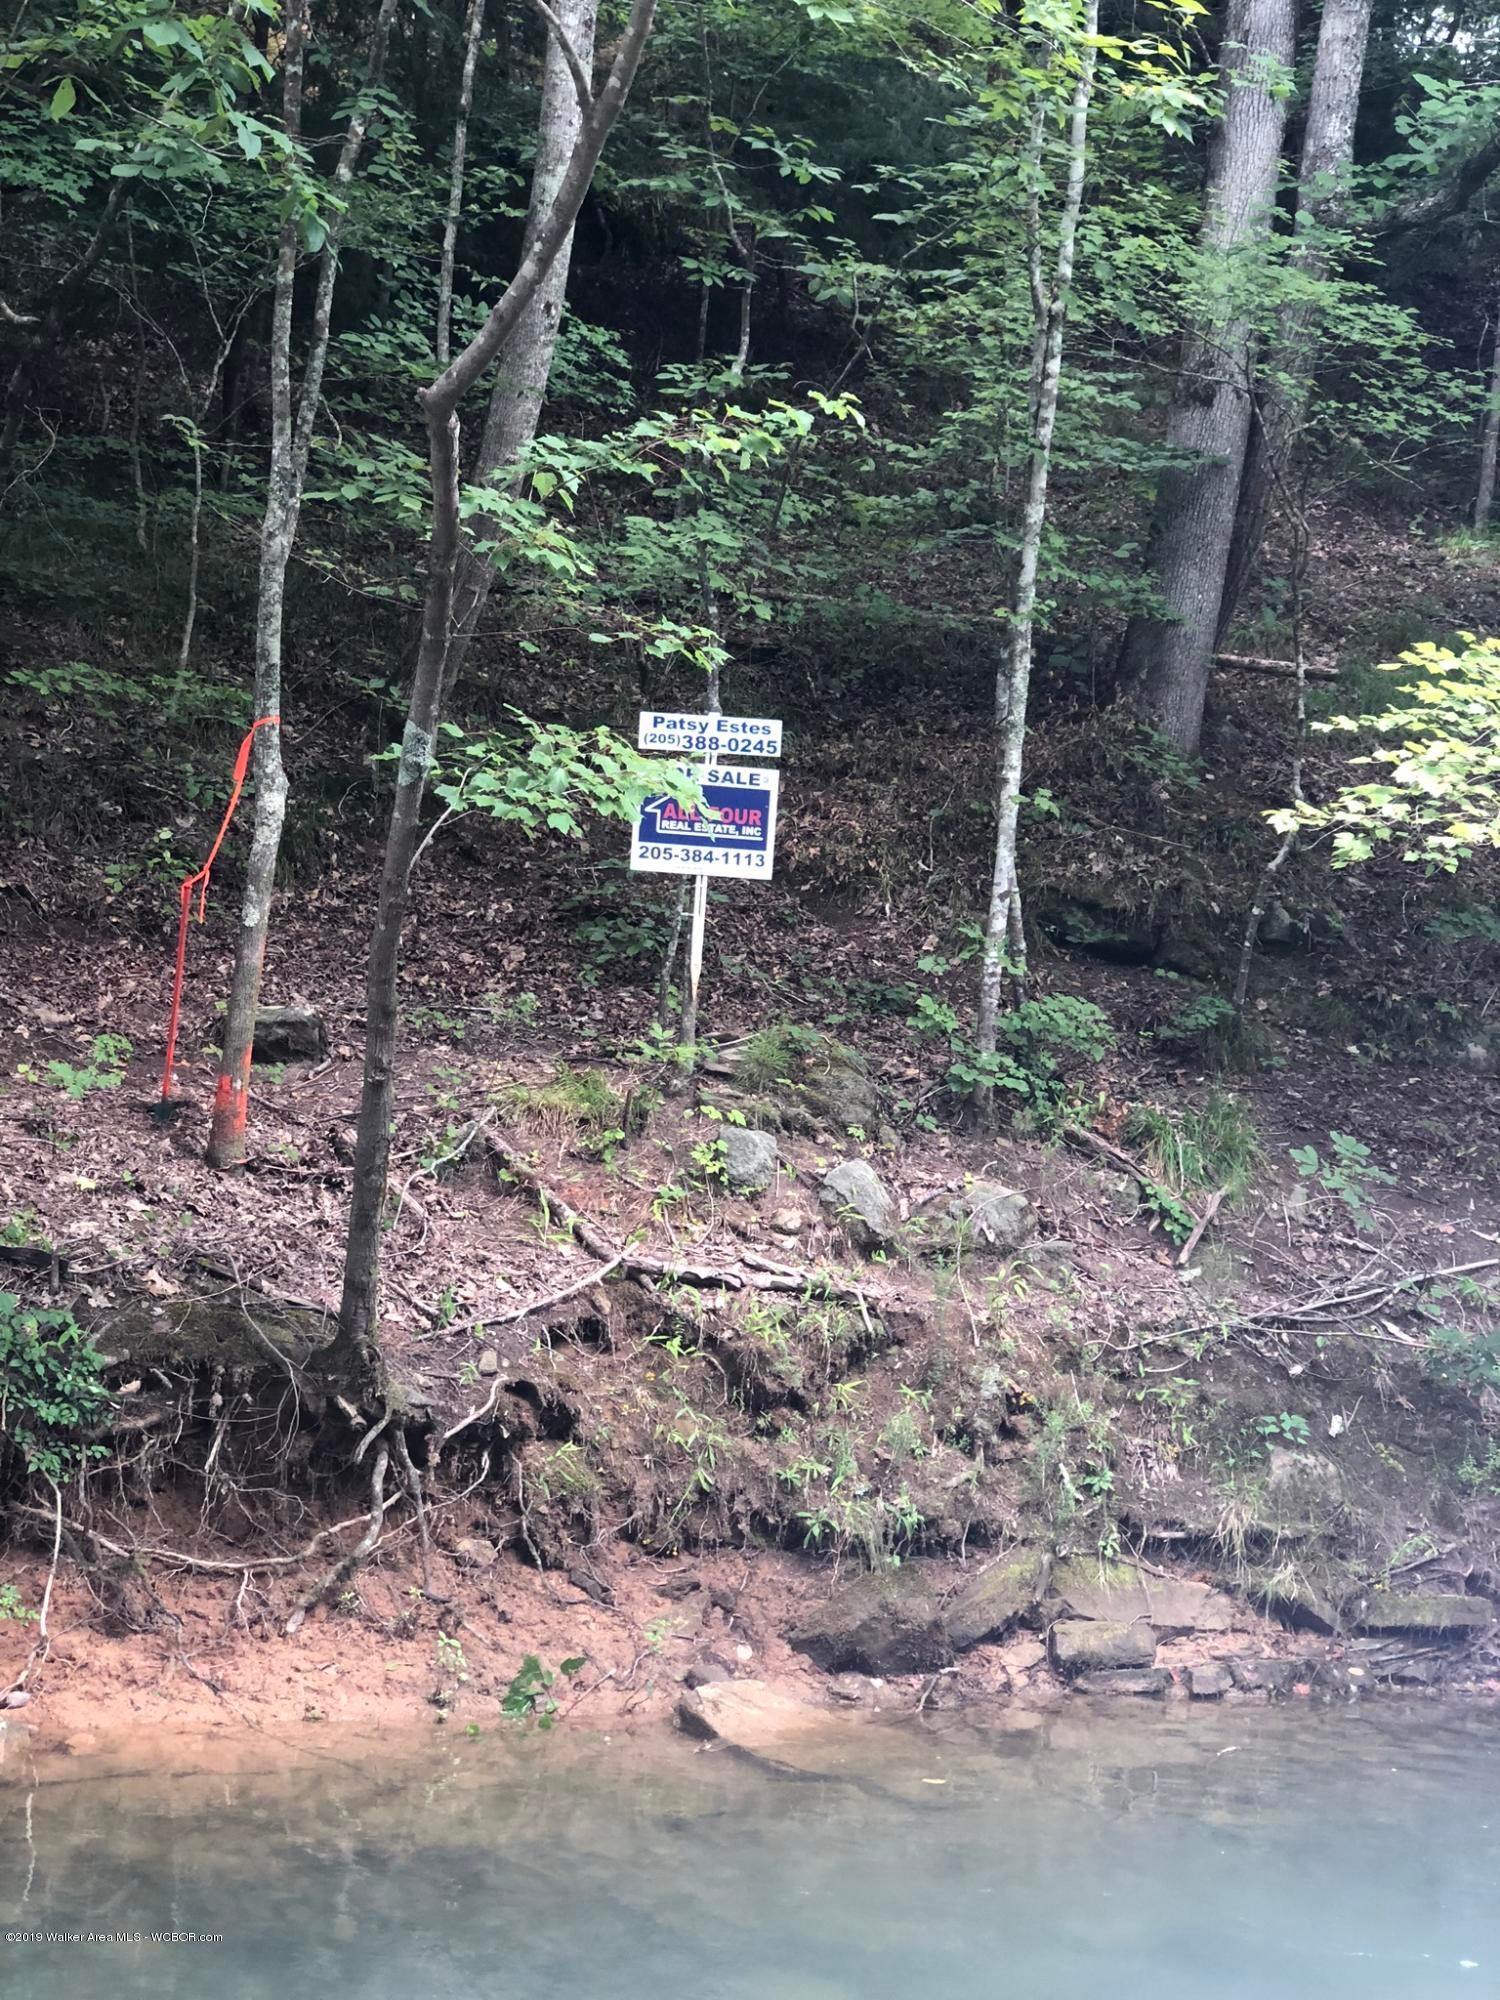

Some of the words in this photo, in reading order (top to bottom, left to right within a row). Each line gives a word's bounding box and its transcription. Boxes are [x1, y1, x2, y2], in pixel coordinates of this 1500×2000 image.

[652, 716, 709, 734] Patsy
[716, 719, 772, 735] Estes
[708, 769, 761, 786] SALE
[661, 819, 692, 831] REAL
[741, 827, 762, 837] INC
[638, 845, 766, 867] 205-384-1113
